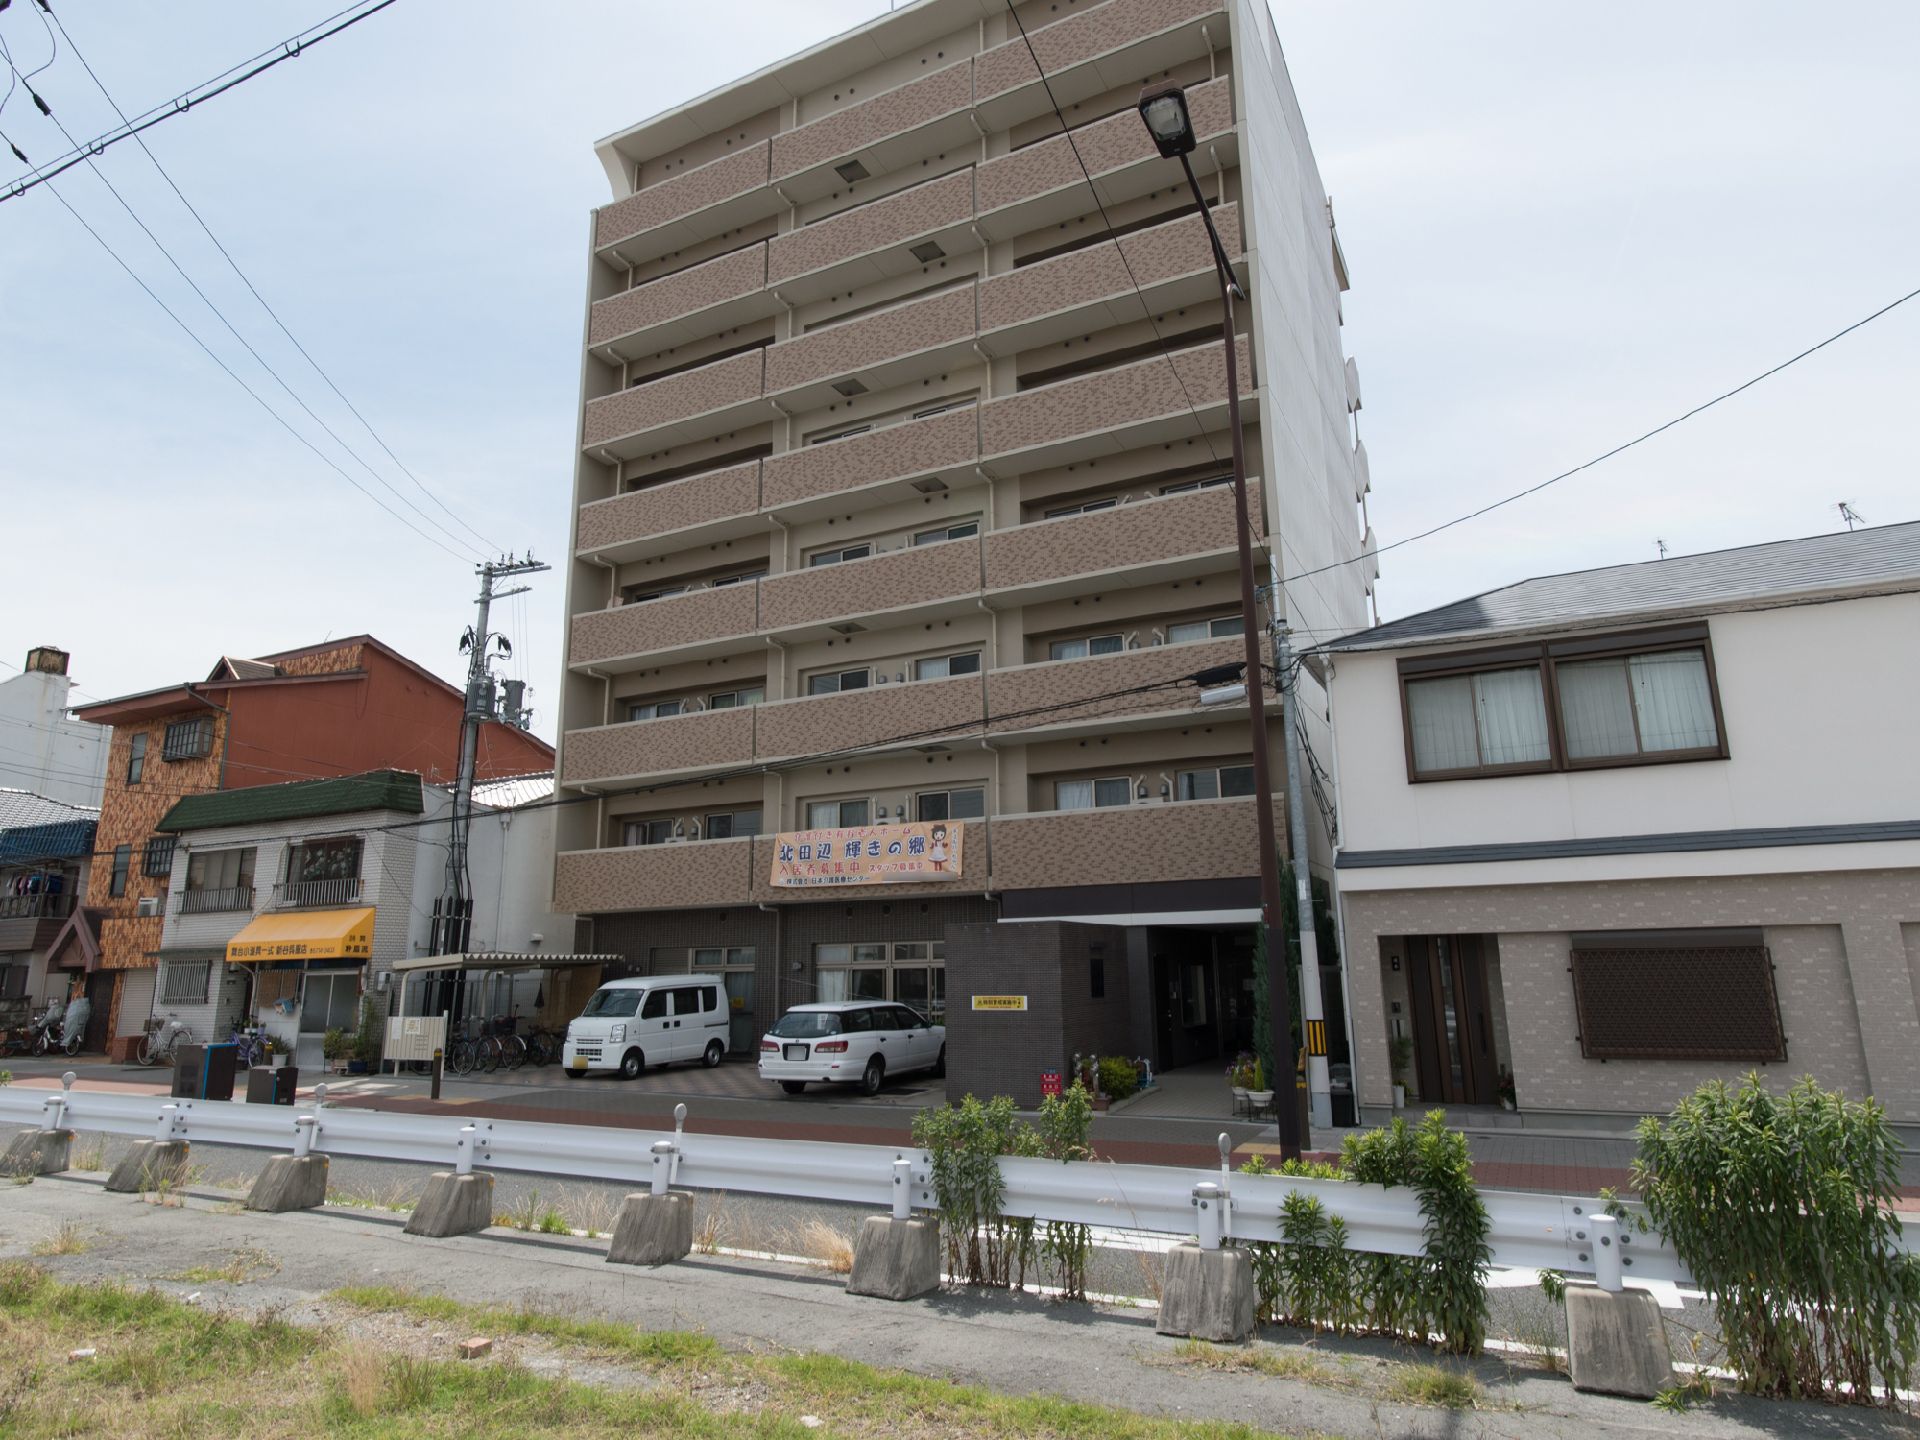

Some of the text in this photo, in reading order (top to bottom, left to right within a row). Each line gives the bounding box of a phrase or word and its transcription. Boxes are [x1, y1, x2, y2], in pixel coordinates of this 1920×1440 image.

[779, 841, 832, 864] 北田辺
[845, 835, 926, 859] 輝きの郷
[779, 861, 860, 876] 入居者募集中
[868, 862, 924, 874] スタッフ募集中
